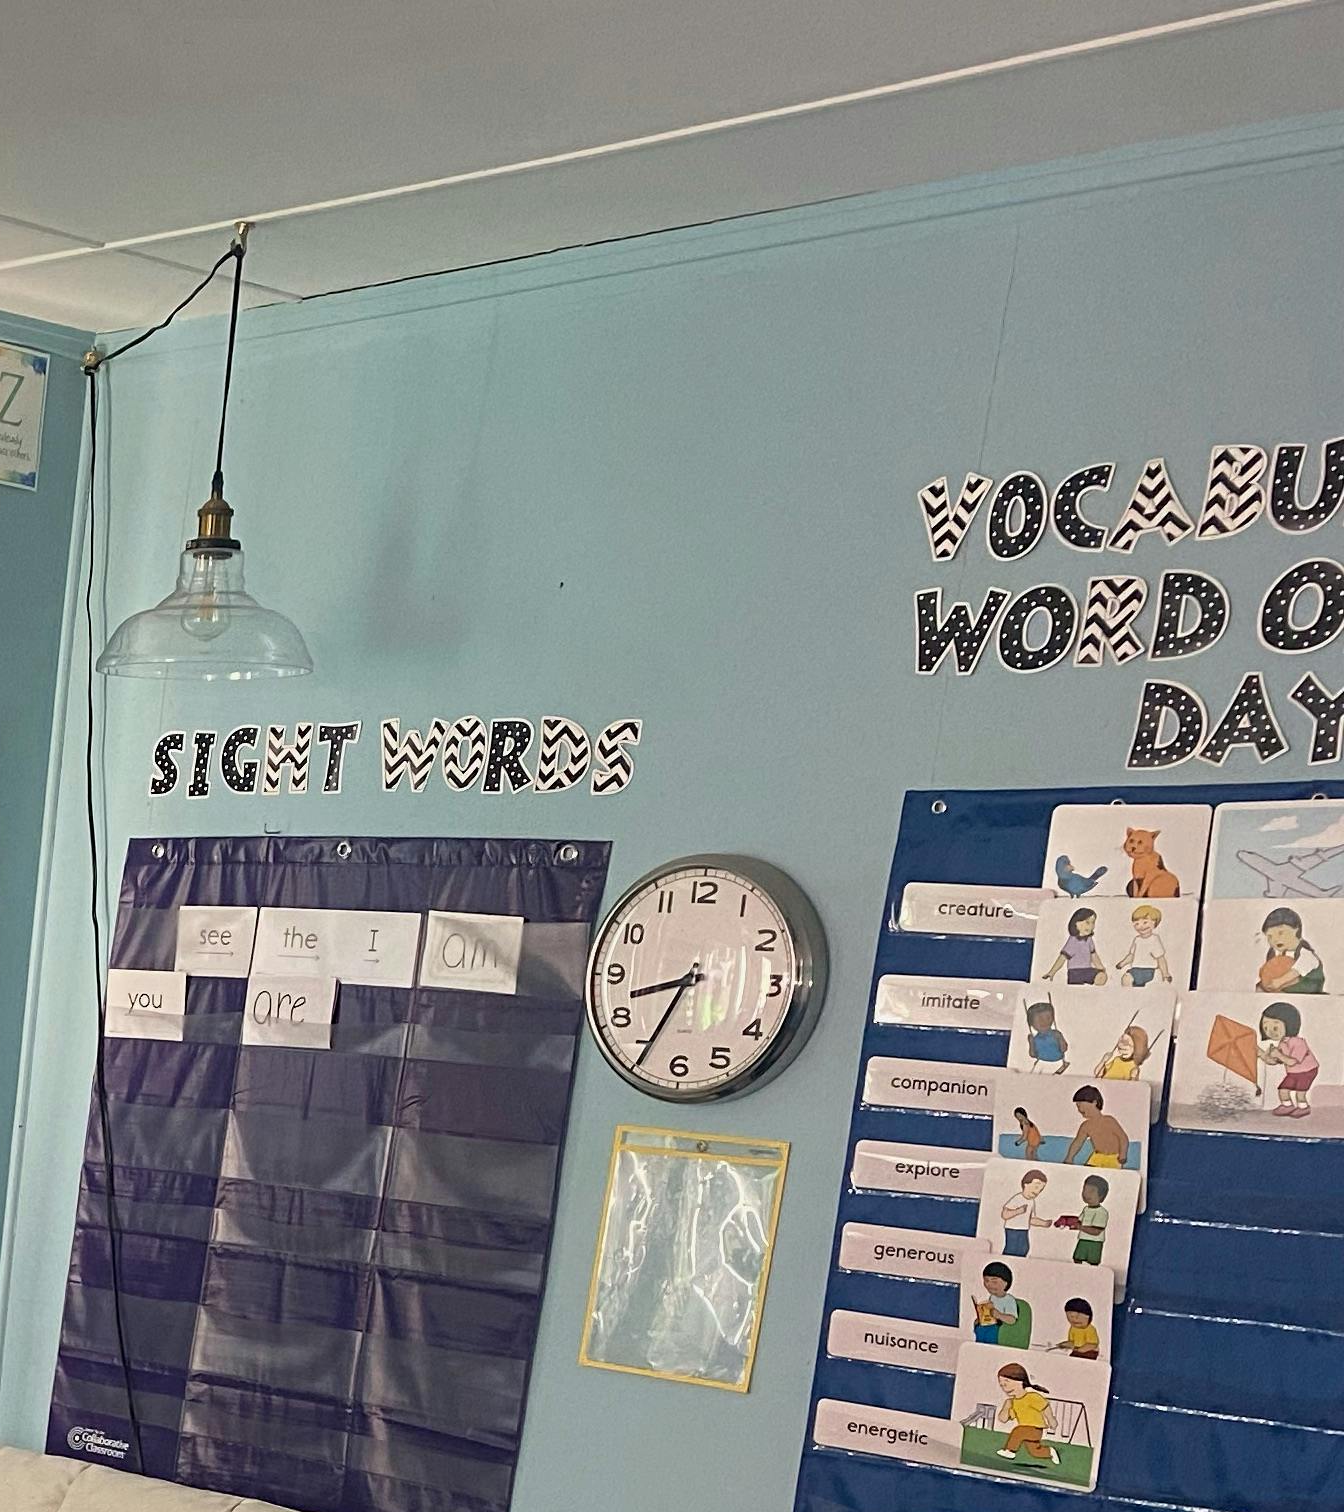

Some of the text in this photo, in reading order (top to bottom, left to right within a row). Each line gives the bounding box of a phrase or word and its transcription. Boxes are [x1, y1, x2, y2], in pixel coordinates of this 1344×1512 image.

[914, 569, 1230, 676] WORD
[1125, 672, 1344, 771] DAY
[149, 715, 643, 798] SIGHT WORDS
[690, 881, 719, 904] 12
[938, 899, 1014, 919] creature
[199, 926, 232, 946] see
[283, 926, 318, 950] the
[368, 928, 379, 954] I
[623, 923, 645, 945] 10
[442, 933, 497, 969] am
[127, 990, 163, 1012] you
[252, 989, 307, 1027] are
[921, 992, 981, 1011] imitate
[669, 1055, 689, 1077] 6
[890, 1074, 989, 1097] companion
[894, 1160, 960, 1180] explore
[873, 1241, 956, 1265] generous
[863, 1329, 940, 1355] nuisance
[846, 1419, 929, 1446] energetic
